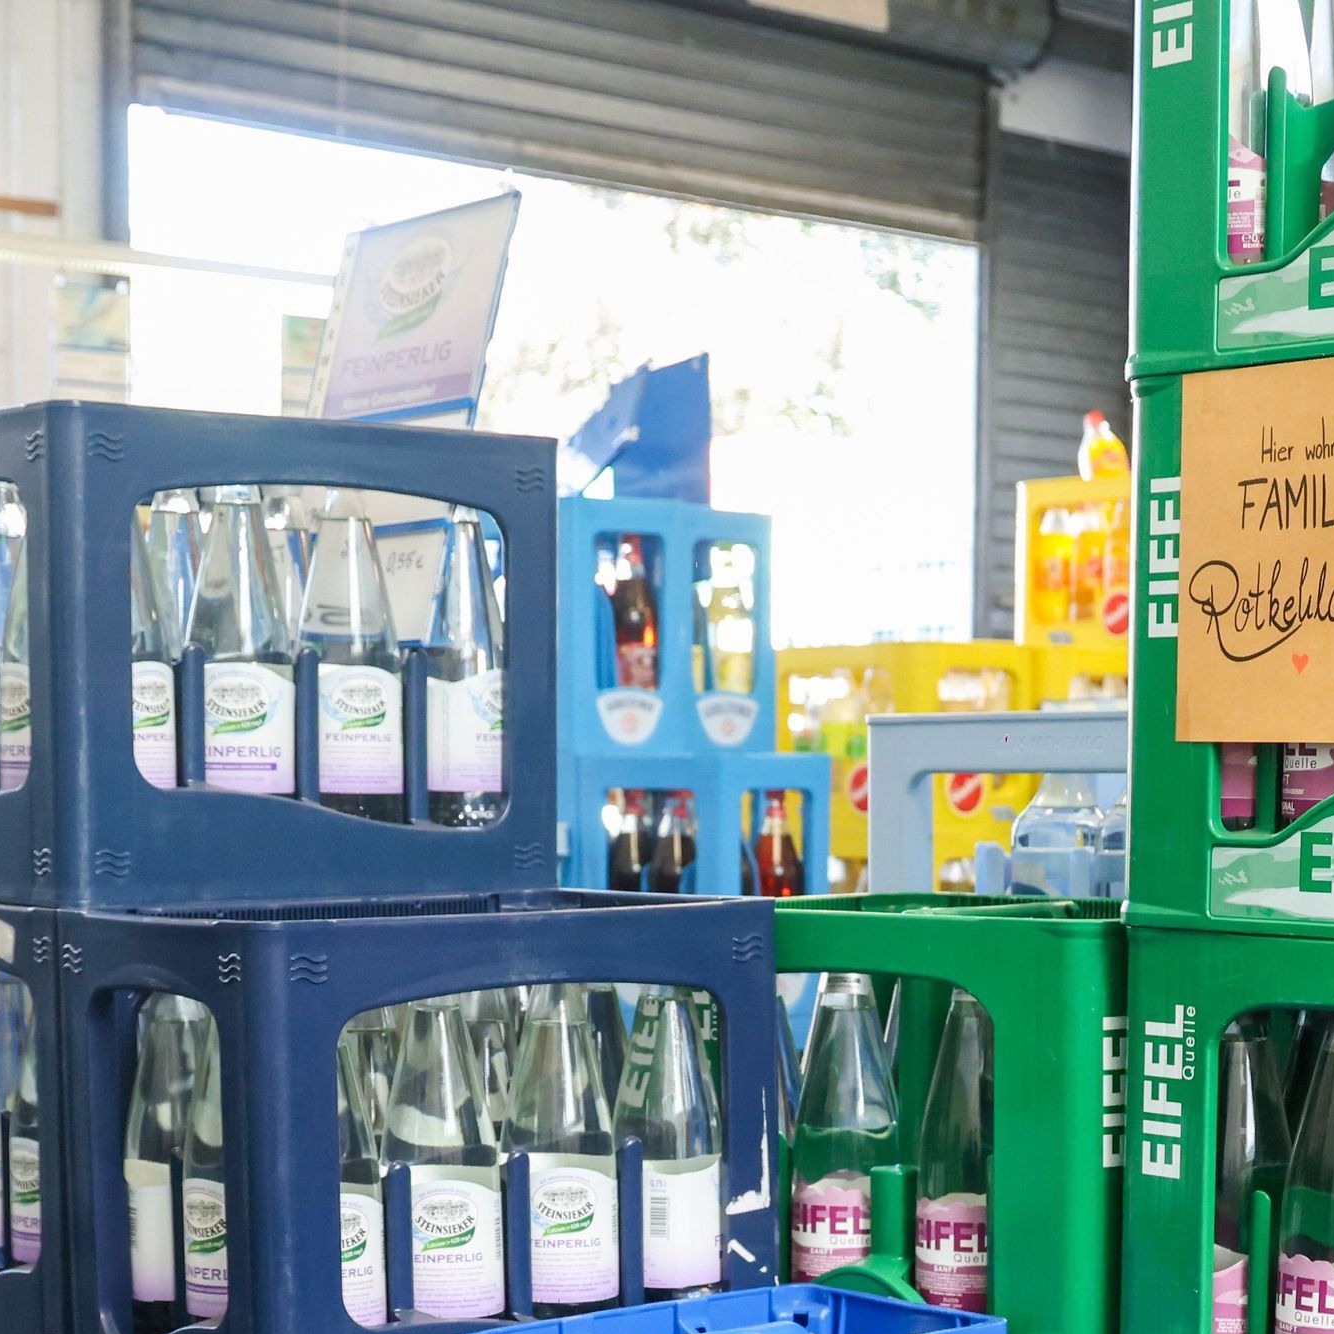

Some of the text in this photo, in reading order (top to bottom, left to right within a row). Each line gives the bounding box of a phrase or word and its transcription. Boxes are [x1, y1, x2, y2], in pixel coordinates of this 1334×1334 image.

[340, 340, 453, 378] FEINPERLIG
[1261, 425, 1294, 464] Hier
[325, 732, 393, 743] FEINPERLIG
[1183, 1005, 1197, 1081] Quelle
[1142, 1004, 1185, 1180] EIFEL
[536, 1201, 594, 1221] STEINSIEKER
[415, 1215, 475, 1235] STEINSIEKER
[414, 1252, 483, 1264] EINPERLIG
[953, 1254, 986, 1265] Quel
[933, 1265, 958, 1274] SANFT
